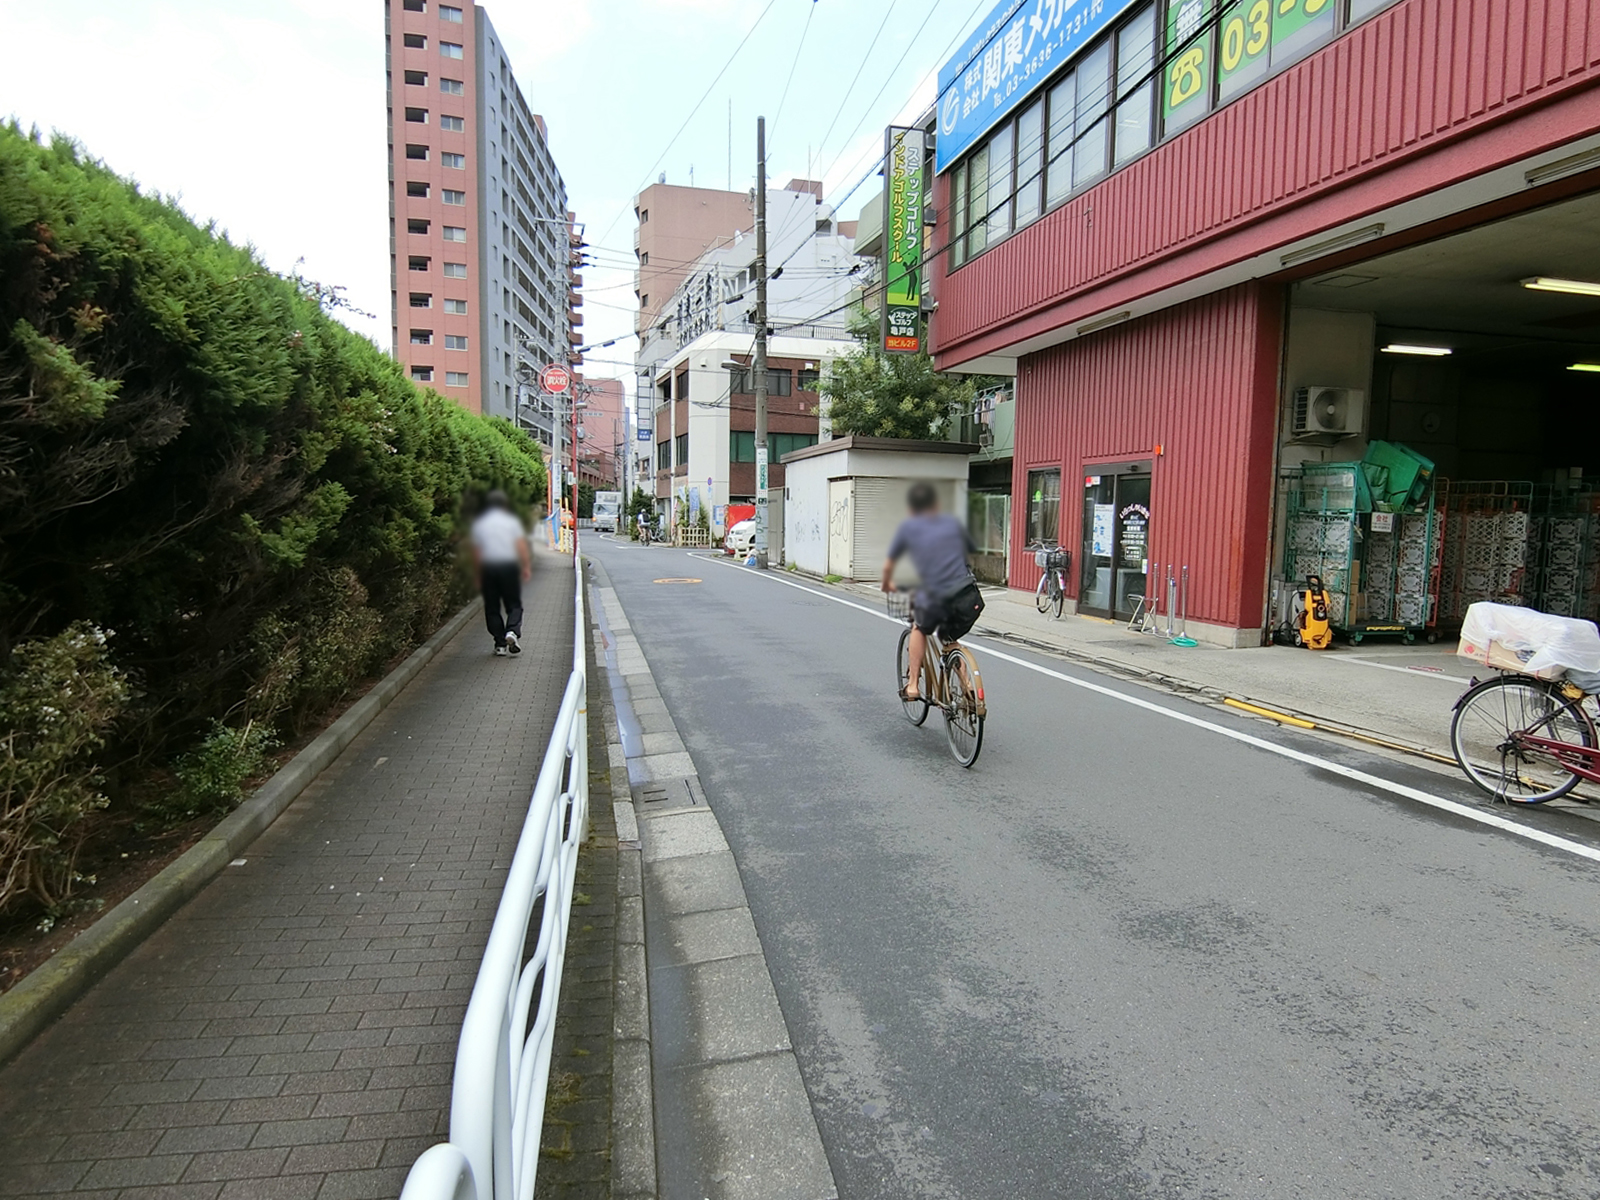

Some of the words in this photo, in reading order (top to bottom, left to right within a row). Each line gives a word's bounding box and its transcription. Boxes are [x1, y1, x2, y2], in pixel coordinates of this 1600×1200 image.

[964, 58, 982, 92] 株式
[962, 87, 980, 119] 会社
[892, 131, 906, 263] インドアゴルフスクール
[906, 147, 920, 249] ステップゴルフ
[890, 326, 915, 337] 亀戸店
[546, 375, 567, 386] 消火栓
